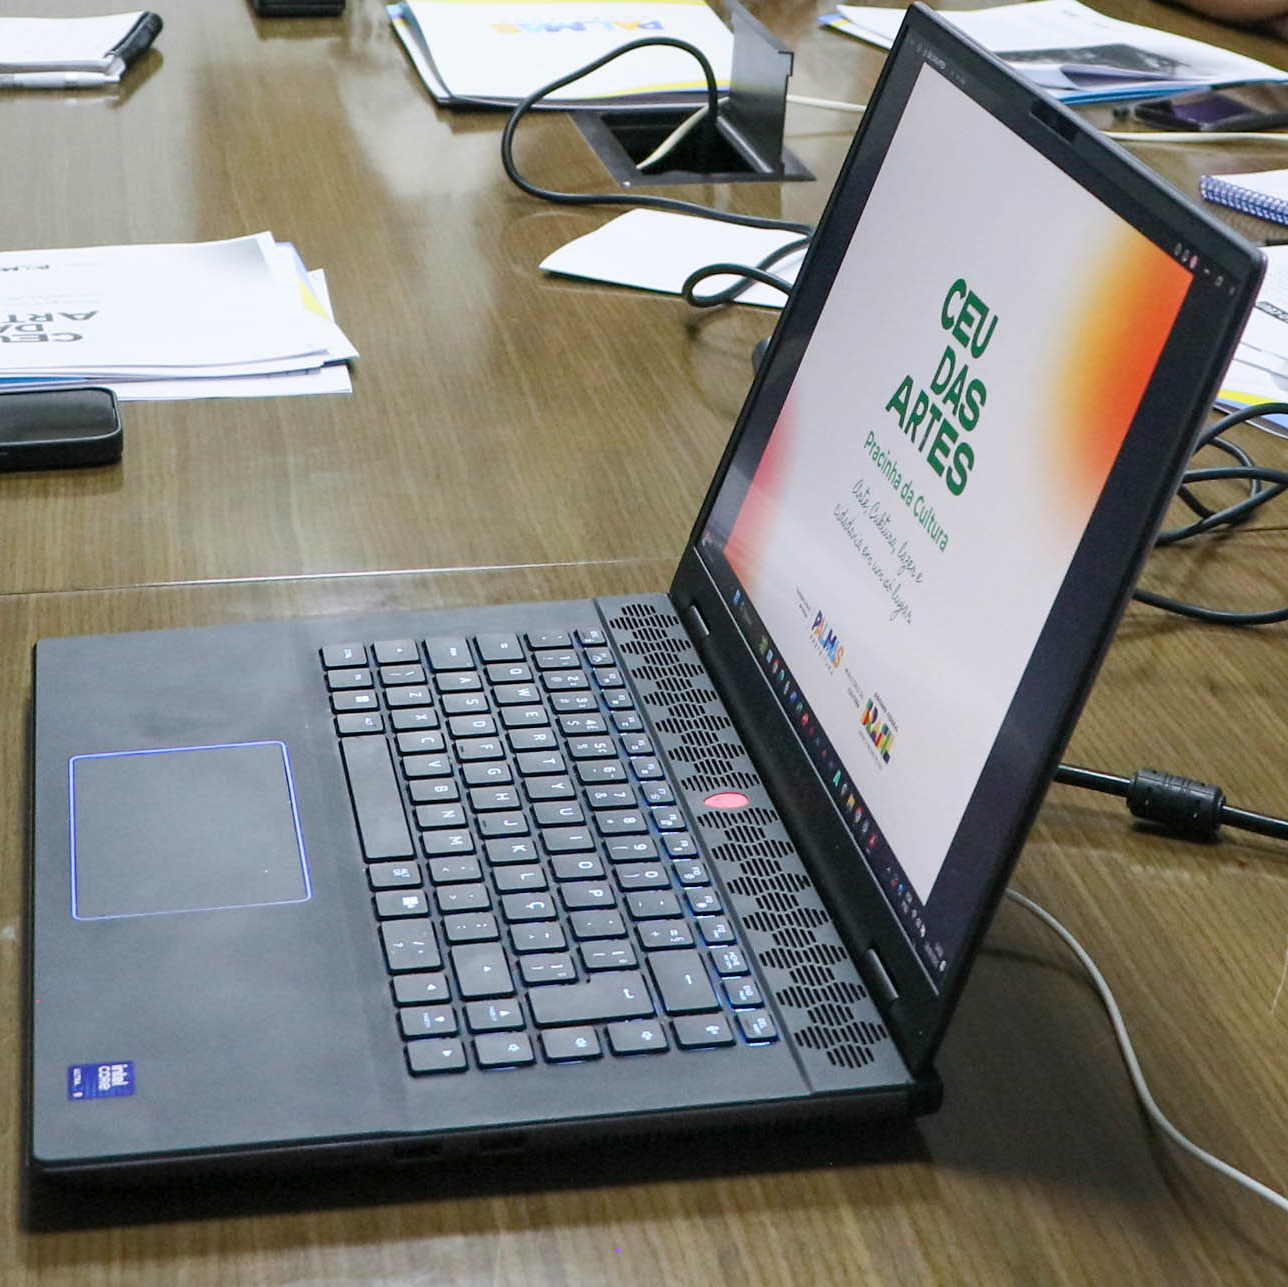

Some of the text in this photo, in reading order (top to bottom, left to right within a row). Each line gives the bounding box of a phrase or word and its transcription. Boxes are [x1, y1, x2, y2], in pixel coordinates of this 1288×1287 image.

[941, 278, 998, 359] CEU
[930, 345, 987, 432] DAS
[885, 375, 975, 496] ARTES
[864, 430, 949, 553] Pracinha da Cultura
[812, 609, 844, 668] PALMAS
[567, 675, 580, 684] 2
[517, 687, 532, 697] W
[465, 698, 480, 706] S
[575, 697, 589, 705] 3
[414, 713, 429, 721] X
[862, 698, 895, 764] BRASIL
[420, 735, 437, 744] C
[533, 733, 547, 741] R
[593, 742, 607, 750] 5
[428, 760, 442, 768] V
[542, 757, 556, 765] T
[487, 767, 502, 776] G
[603, 766, 617, 776] 6
[434, 785, 449, 793] B
[550, 782, 565, 790] Y
[495, 792, 510, 801] H
[440, 809, 456, 819] N
[559, 807, 575, 816] U
[622, 816, 637, 825] 8
[448, 835, 464, 846] M
[511, 844, 527, 853] K
[633, 843, 648, 851] 9
[520, 872, 535, 881] L
[588, 889, 604, 898] P
